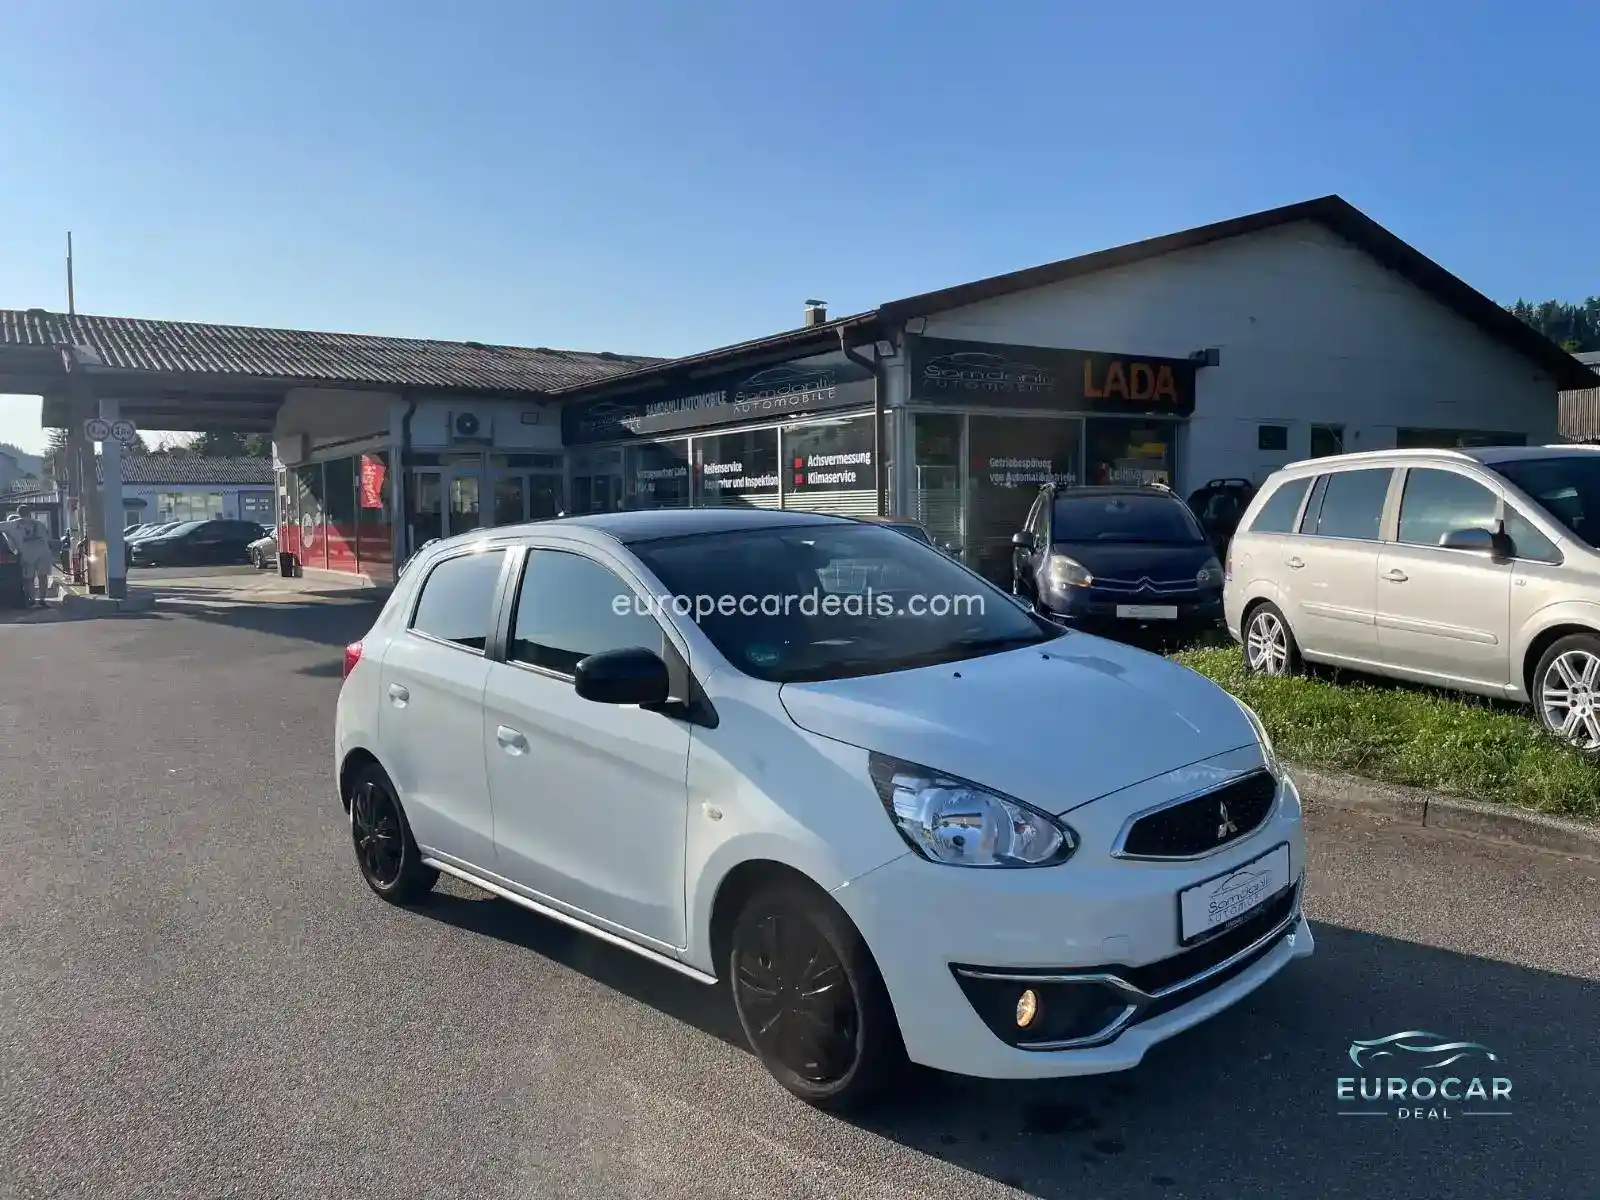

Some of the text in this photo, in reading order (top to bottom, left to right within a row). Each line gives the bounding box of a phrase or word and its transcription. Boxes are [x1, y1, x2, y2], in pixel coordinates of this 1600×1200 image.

[1083, 358, 1177, 403] LADA
[733, 389, 836, 414] AUTOMOBILE
[807, 452, 871, 467] Achsvermessung
[704, 461, 742, 475] Reifenservice
[733, 476, 744, 488] und
[745, 474, 779, 488] Inspektion
[807, 470, 857, 485] Klimaservice
